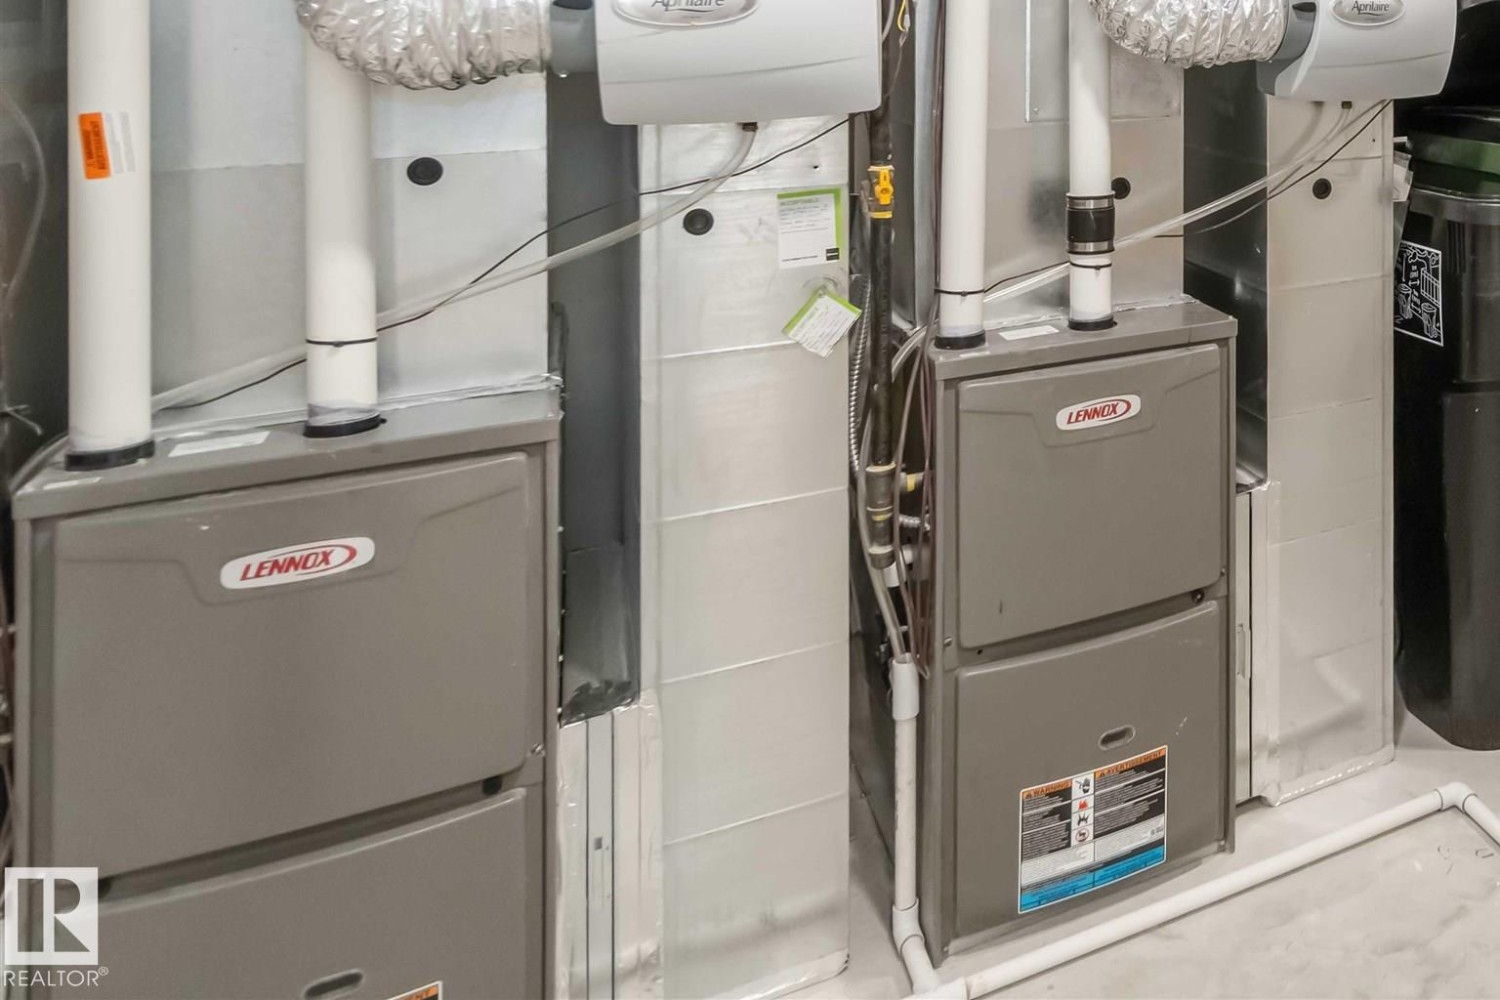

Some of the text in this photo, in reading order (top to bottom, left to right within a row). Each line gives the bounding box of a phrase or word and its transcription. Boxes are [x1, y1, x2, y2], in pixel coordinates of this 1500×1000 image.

[1352, 0, 1390, 15] Aprilaire
[1067, 402, 1119, 425] LENNOX
[239, 549, 335, 581] LENNOX
